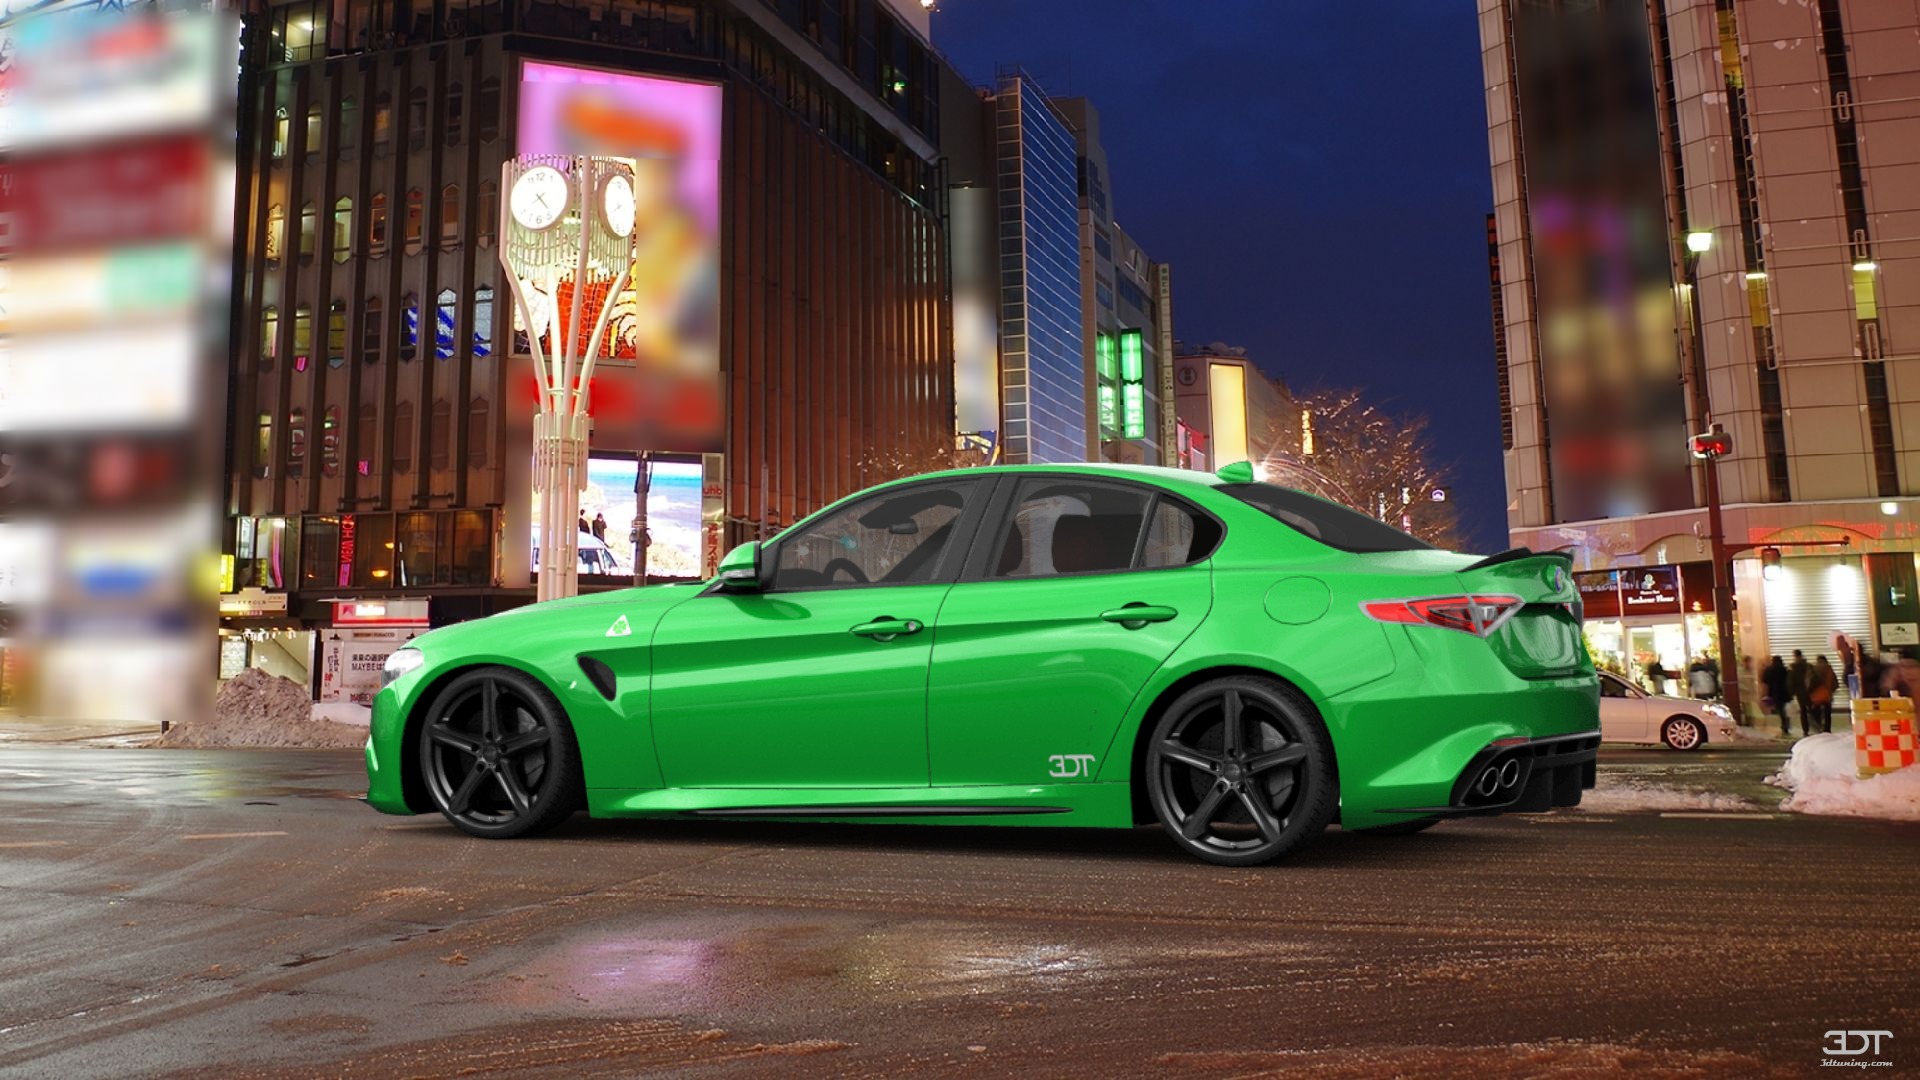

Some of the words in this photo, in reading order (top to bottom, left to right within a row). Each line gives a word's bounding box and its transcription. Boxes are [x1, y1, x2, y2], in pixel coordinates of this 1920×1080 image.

[536, 172, 546, 182] 12
[536, 215, 543, 225] 6
[703, 485, 723, 496] uhb
[1049, 754, 1096, 778] 3DT
